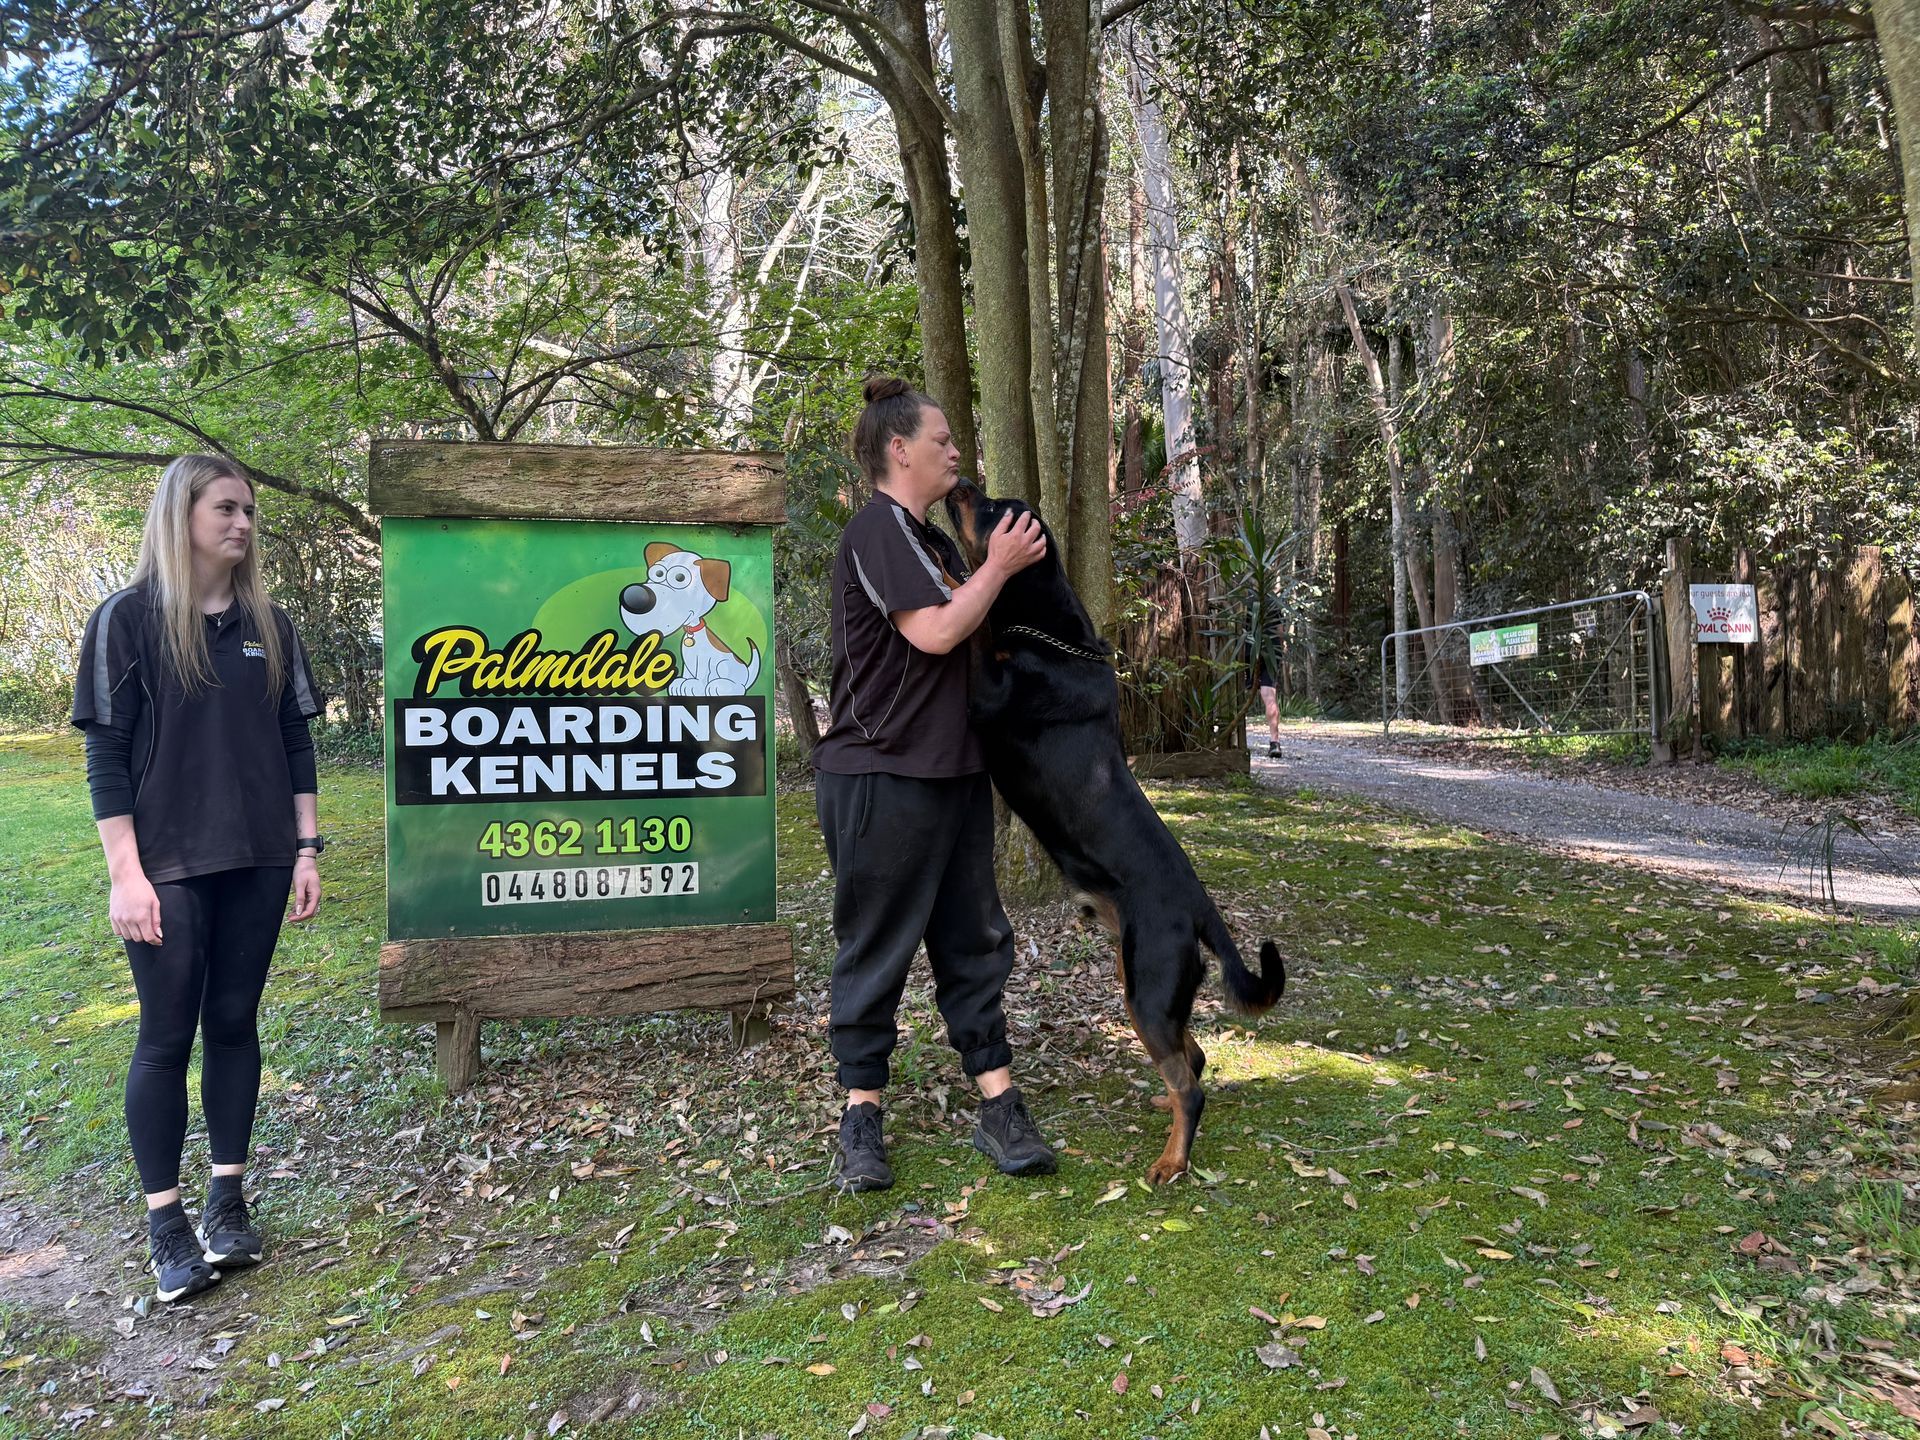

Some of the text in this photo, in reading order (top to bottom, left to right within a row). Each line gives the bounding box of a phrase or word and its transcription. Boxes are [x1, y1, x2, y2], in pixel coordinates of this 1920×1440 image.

[1700, 590, 1724, 599] guests
[1697, 623, 1752, 633] OYAL CANIN
[422, 627, 676, 695] Palmdale
[404, 703, 757, 747] BOARDING
[430, 751, 737, 795] KENNELS
[479, 816, 692, 857] 4362 1130
[486, 865, 695, 904] 0448087592
